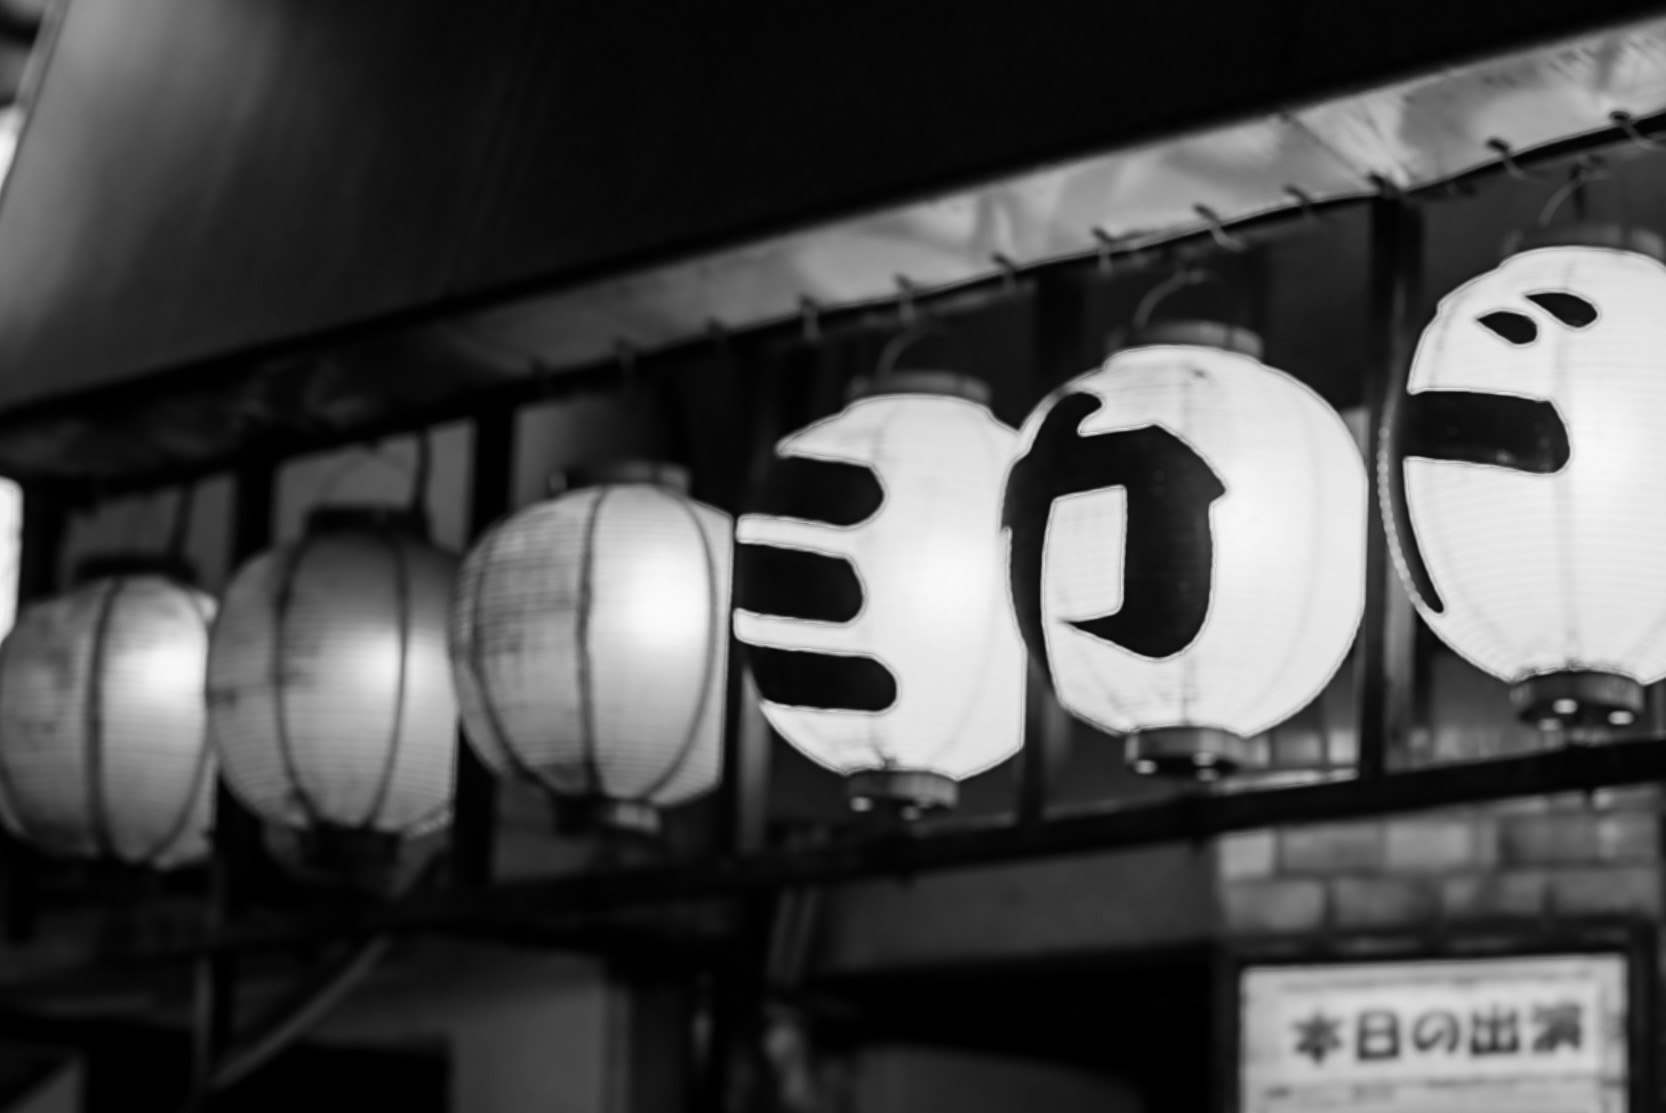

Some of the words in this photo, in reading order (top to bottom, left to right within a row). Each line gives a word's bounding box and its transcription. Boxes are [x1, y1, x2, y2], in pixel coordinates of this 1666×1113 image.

[1293, 1003, 1584, 1064] 本日の出演
